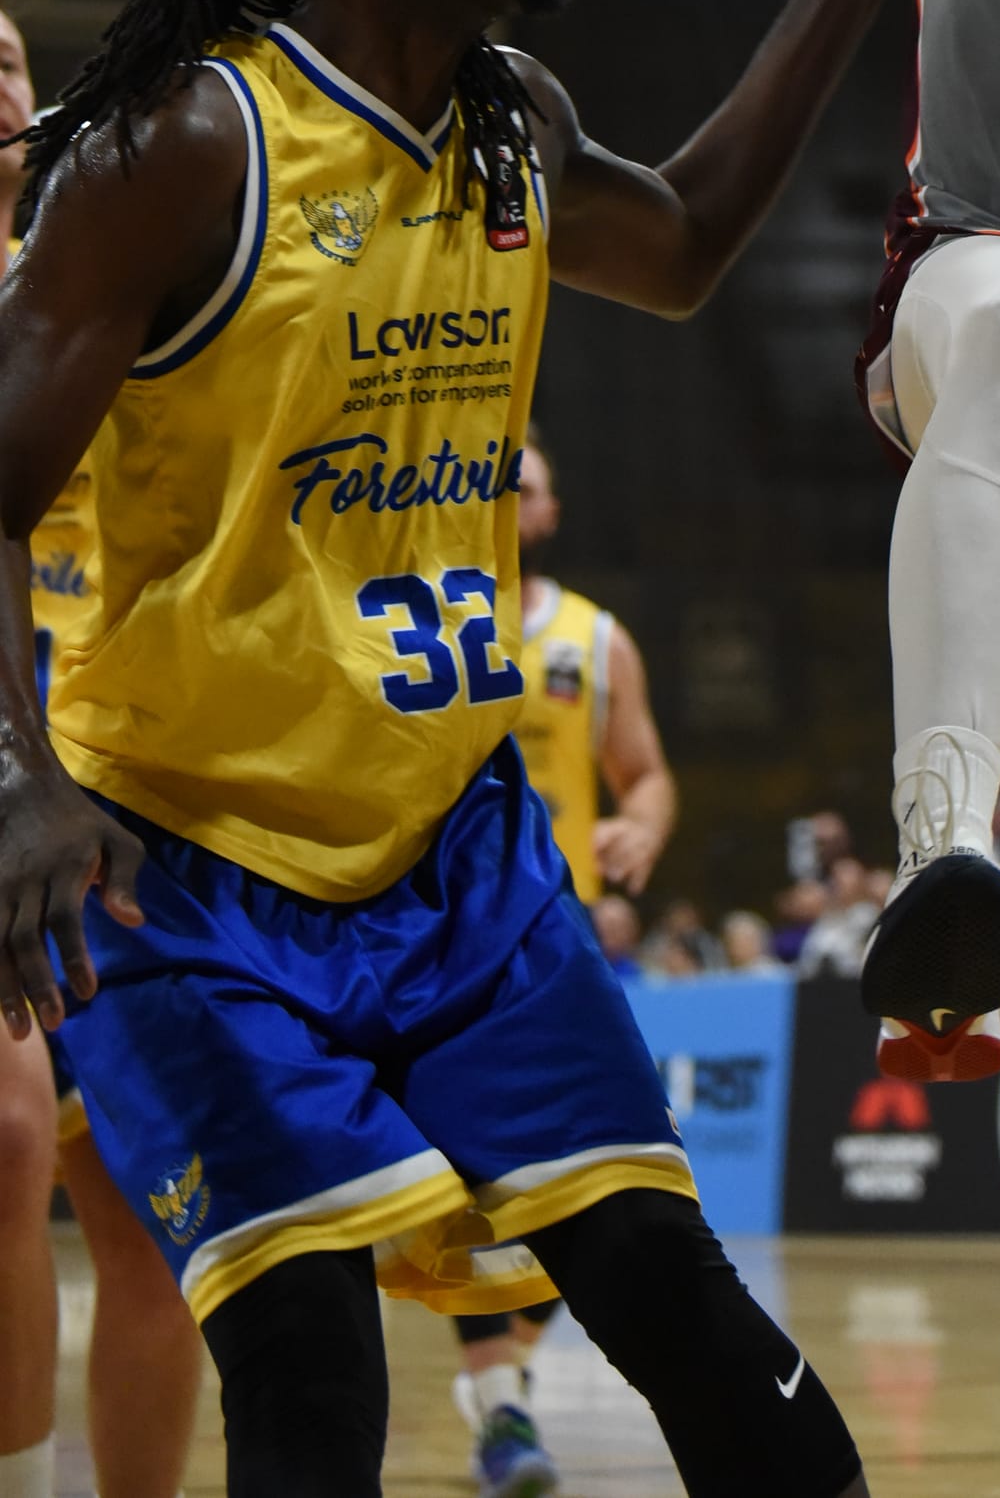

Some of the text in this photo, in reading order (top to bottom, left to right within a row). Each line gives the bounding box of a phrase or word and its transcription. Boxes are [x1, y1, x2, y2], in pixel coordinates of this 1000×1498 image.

[347, 307, 511, 361] Lawson
[410, 385, 437, 406] for
[355, 565, 525, 716] 32
